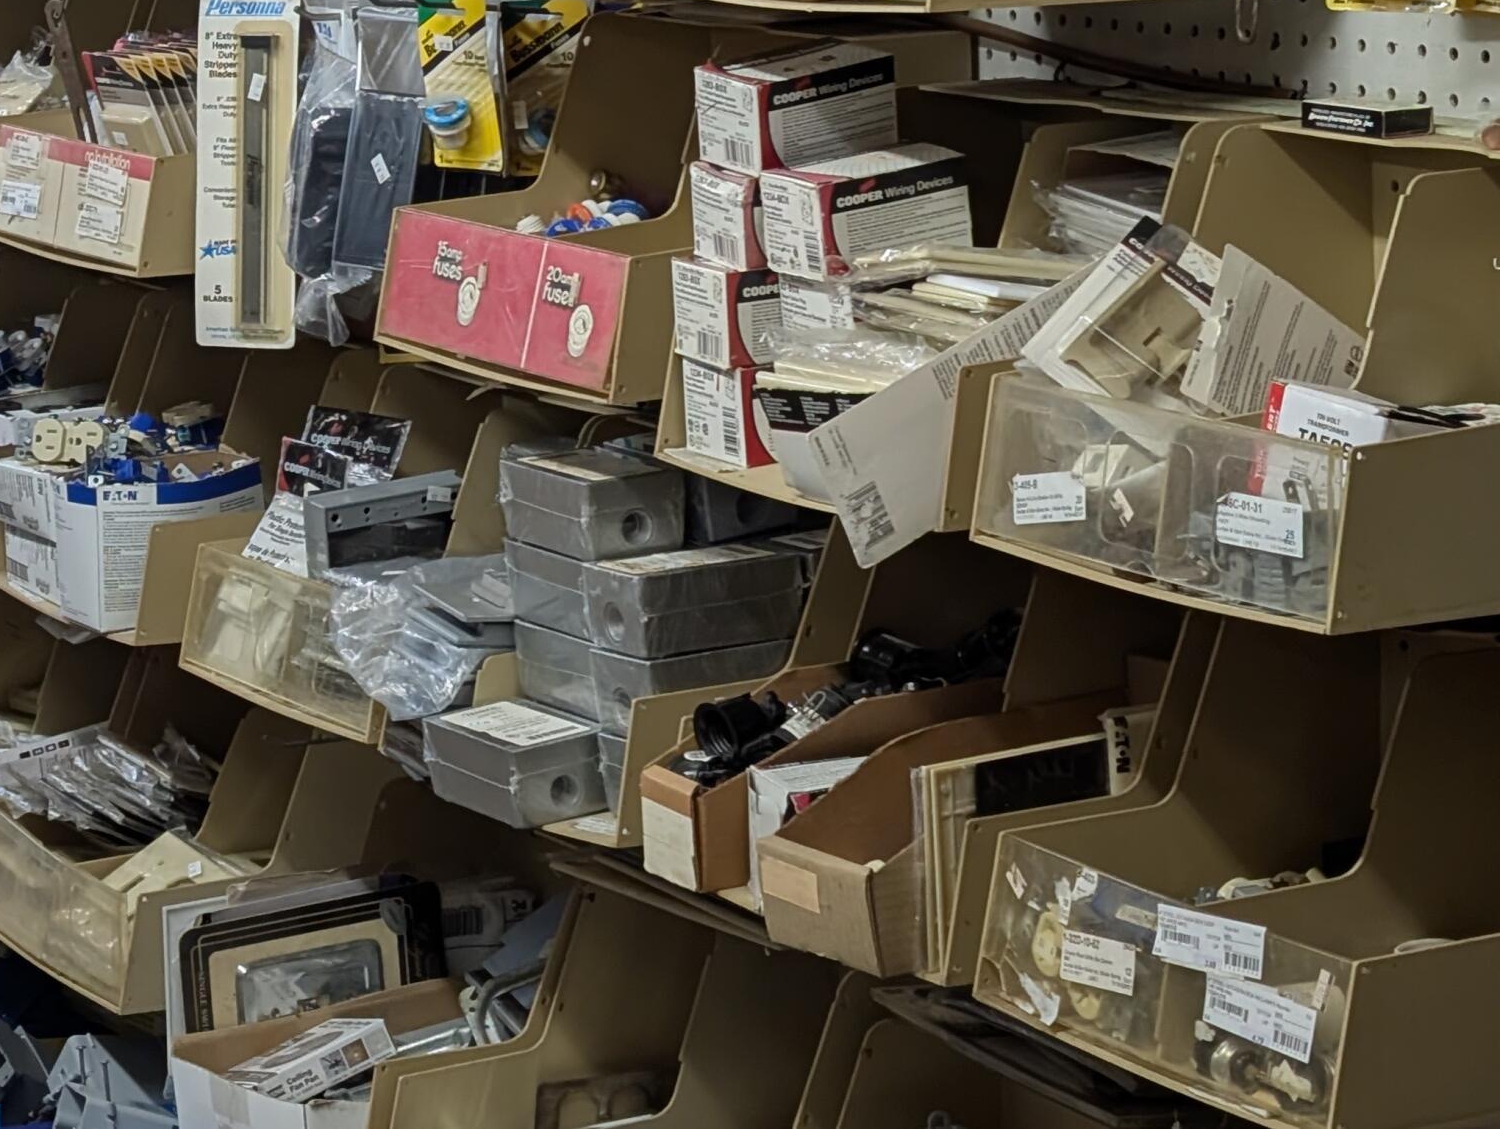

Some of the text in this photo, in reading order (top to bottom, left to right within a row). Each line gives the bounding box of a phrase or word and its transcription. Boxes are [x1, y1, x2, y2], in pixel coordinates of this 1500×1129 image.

[211, 41, 238, 51] Heavy
[217, 51, 238, 61] Duty
[204, 60, 239, 71] Stripper
[208, 70, 238, 79] Blades
[772, 72, 885, 107] COOPER Wiring Devices
[835, 174, 954, 209] COOPER Wiring Devices
[431, 255, 464, 282] fuses
[214, 284, 222, 295] 5
[541, 280, 575, 308] fuse
[742, 283, 780, 298] COOPE
[203, 295, 233, 303] BLADES
